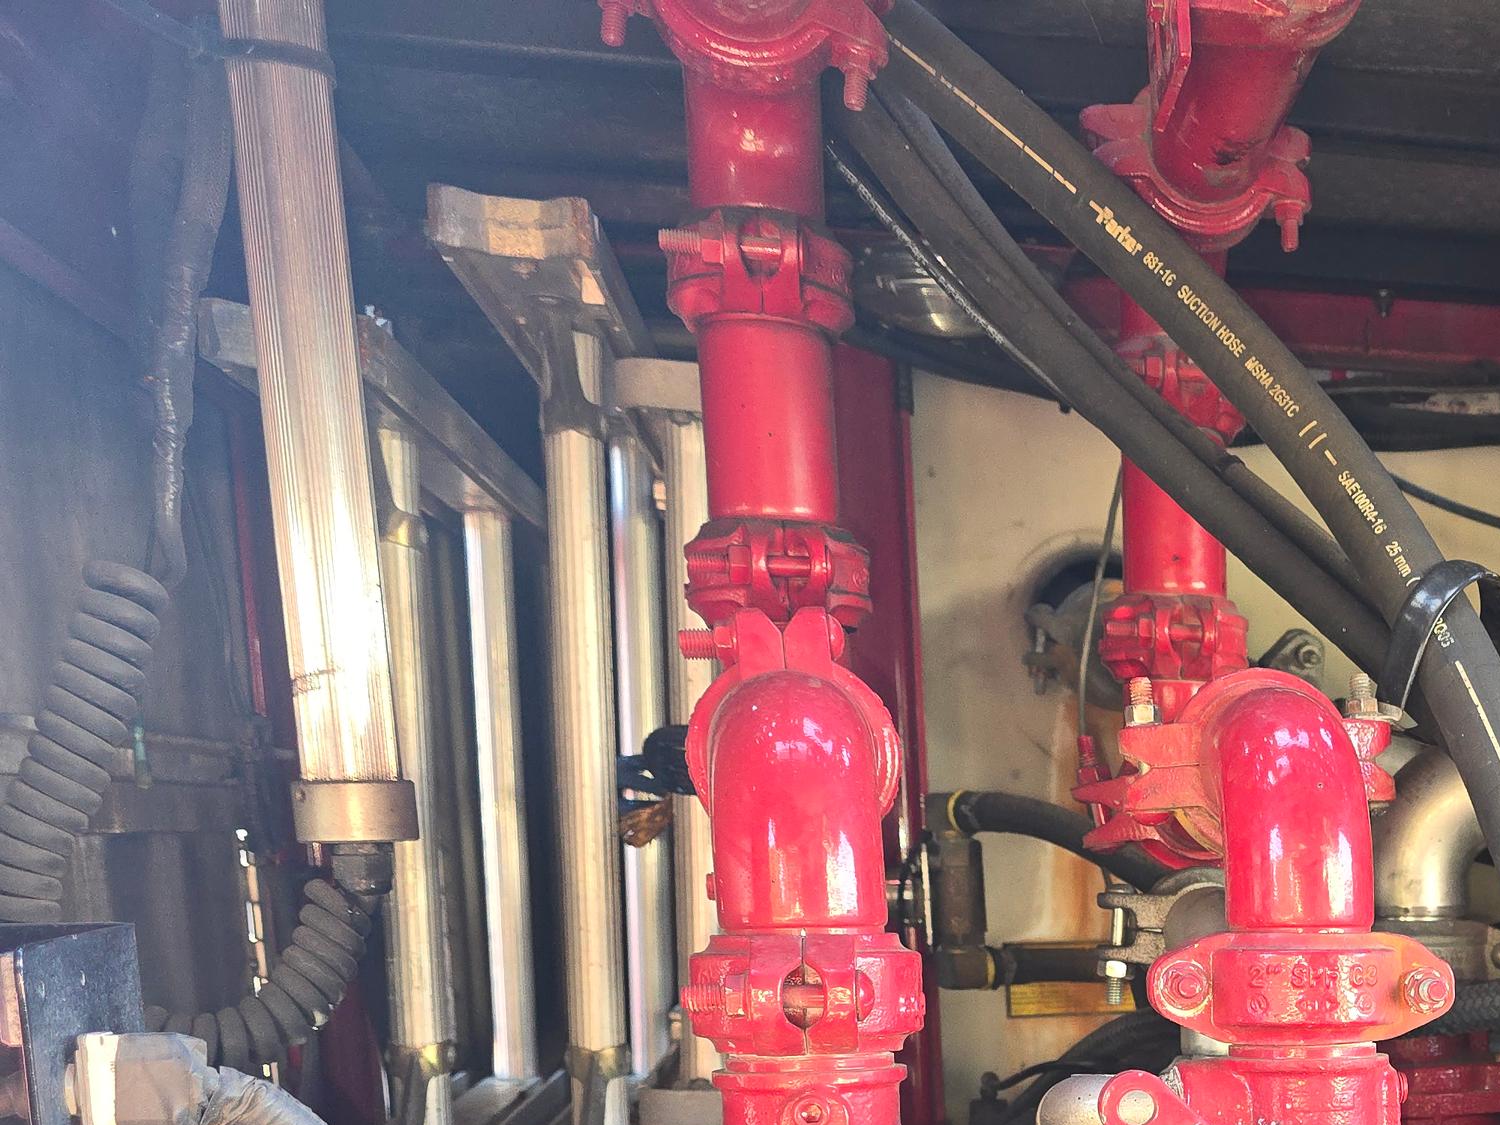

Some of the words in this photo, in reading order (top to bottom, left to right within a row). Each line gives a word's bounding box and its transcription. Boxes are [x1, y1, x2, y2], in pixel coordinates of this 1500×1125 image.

[1089, 200, 1143, 256] Parker
[1142, 251, 1177, 287] 881-16
[1177, 284, 1222, 332] SUCTION
[1215, 325, 1247, 358] HOSE
[1244, 356, 1273, 389] MSHA
[1269, 383, 1300, 418] 2G31C
[1338, 470, 1388, 535] SAE100R4-16
[1384, 541, 1403, 557] 25
[1393, 554, 1412, 578] mm
